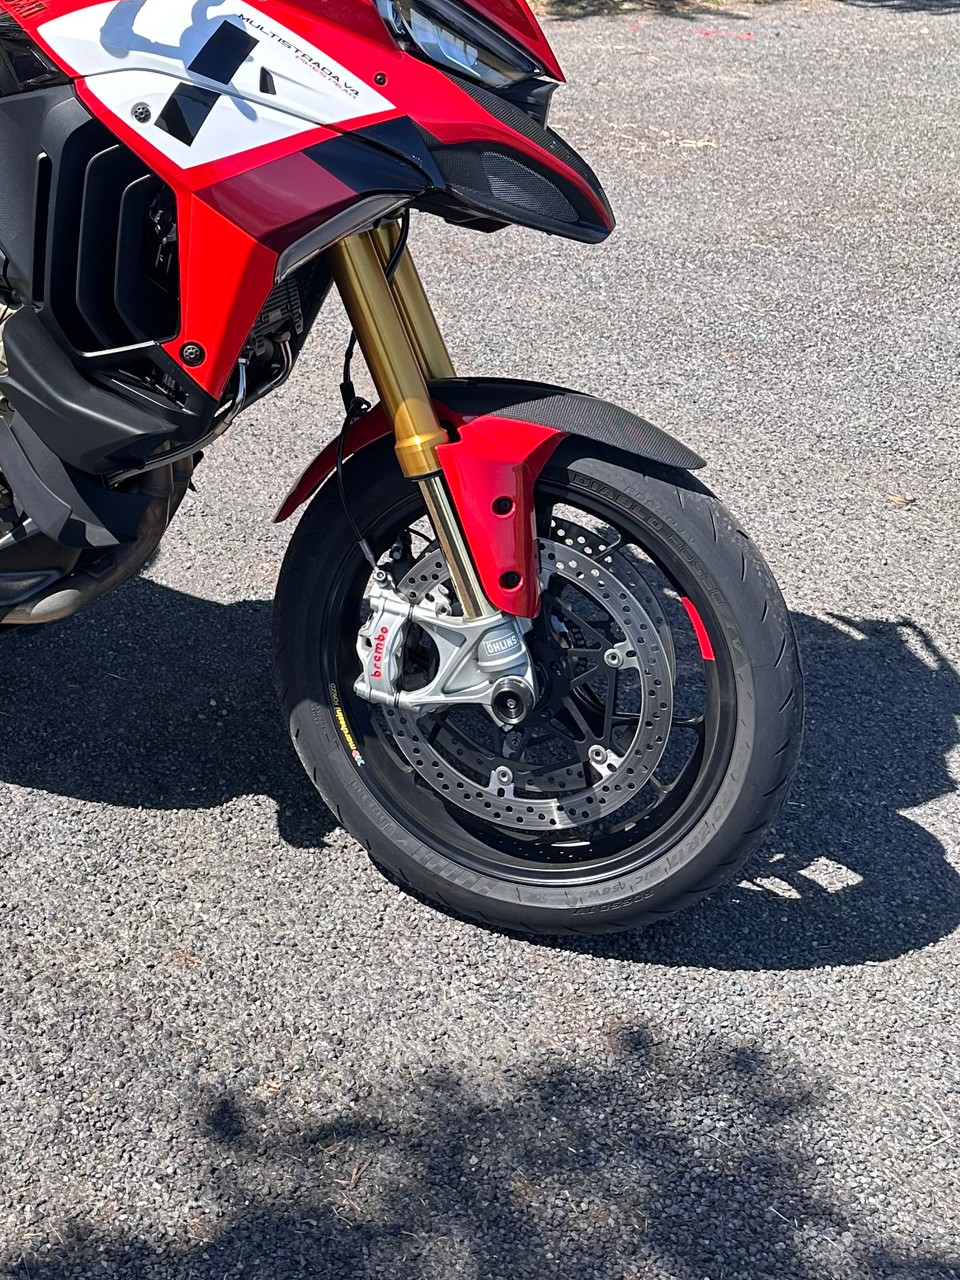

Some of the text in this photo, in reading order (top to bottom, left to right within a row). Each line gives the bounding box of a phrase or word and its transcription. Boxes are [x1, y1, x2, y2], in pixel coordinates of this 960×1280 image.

[238, 13, 360, 96] MULTISTRADA V4
[371, 626, 389, 679] brembo
[486, 634, 518, 653] ÖHLINS
